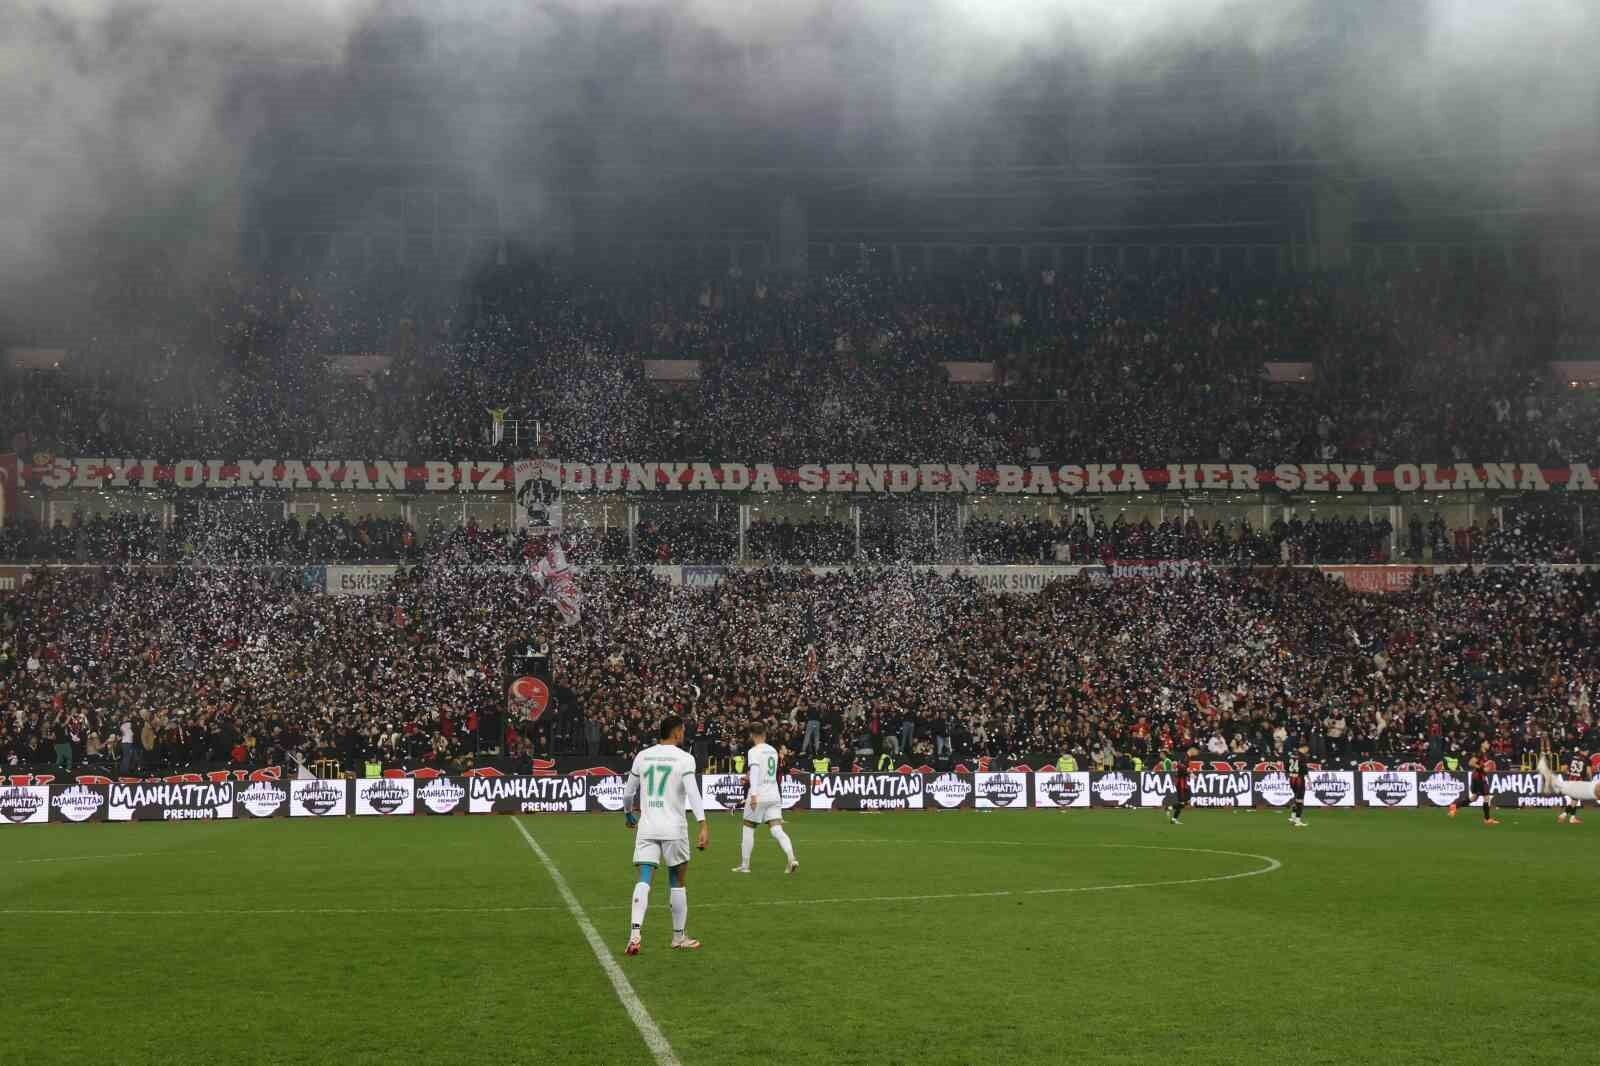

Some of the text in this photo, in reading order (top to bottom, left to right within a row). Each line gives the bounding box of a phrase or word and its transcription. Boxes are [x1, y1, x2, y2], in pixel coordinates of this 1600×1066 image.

[175, 459, 408, 489] OLMAYAN
[799, 464, 976, 492] SENDEN
[1167, 464, 1259, 490] HER
[1393, 463, 1550, 491] OLANA
[768, 756, 776, 777] 9
[1289, 760, 1299, 772] 24
[1570, 760, 1584, 773] 53
[644, 764, 673, 797] 17
[813, 775, 921, 797] MANHATTAN
[113, 782, 231, 807] MANHATTAN
[417, 787, 464, 799] MANHATTAN
[472, 777, 584, 799] MANHATTAN
[237, 790, 286, 802] MANHATTAN
[1191, 796, 1235, 807] PREMIUM
[1518, 796, 1564, 807] PREMIUM
[521, 801, 567, 812] PREMIUM
[860, 798, 906, 809] PREMIUM
[163, 807, 214, 820] PREMIUM
